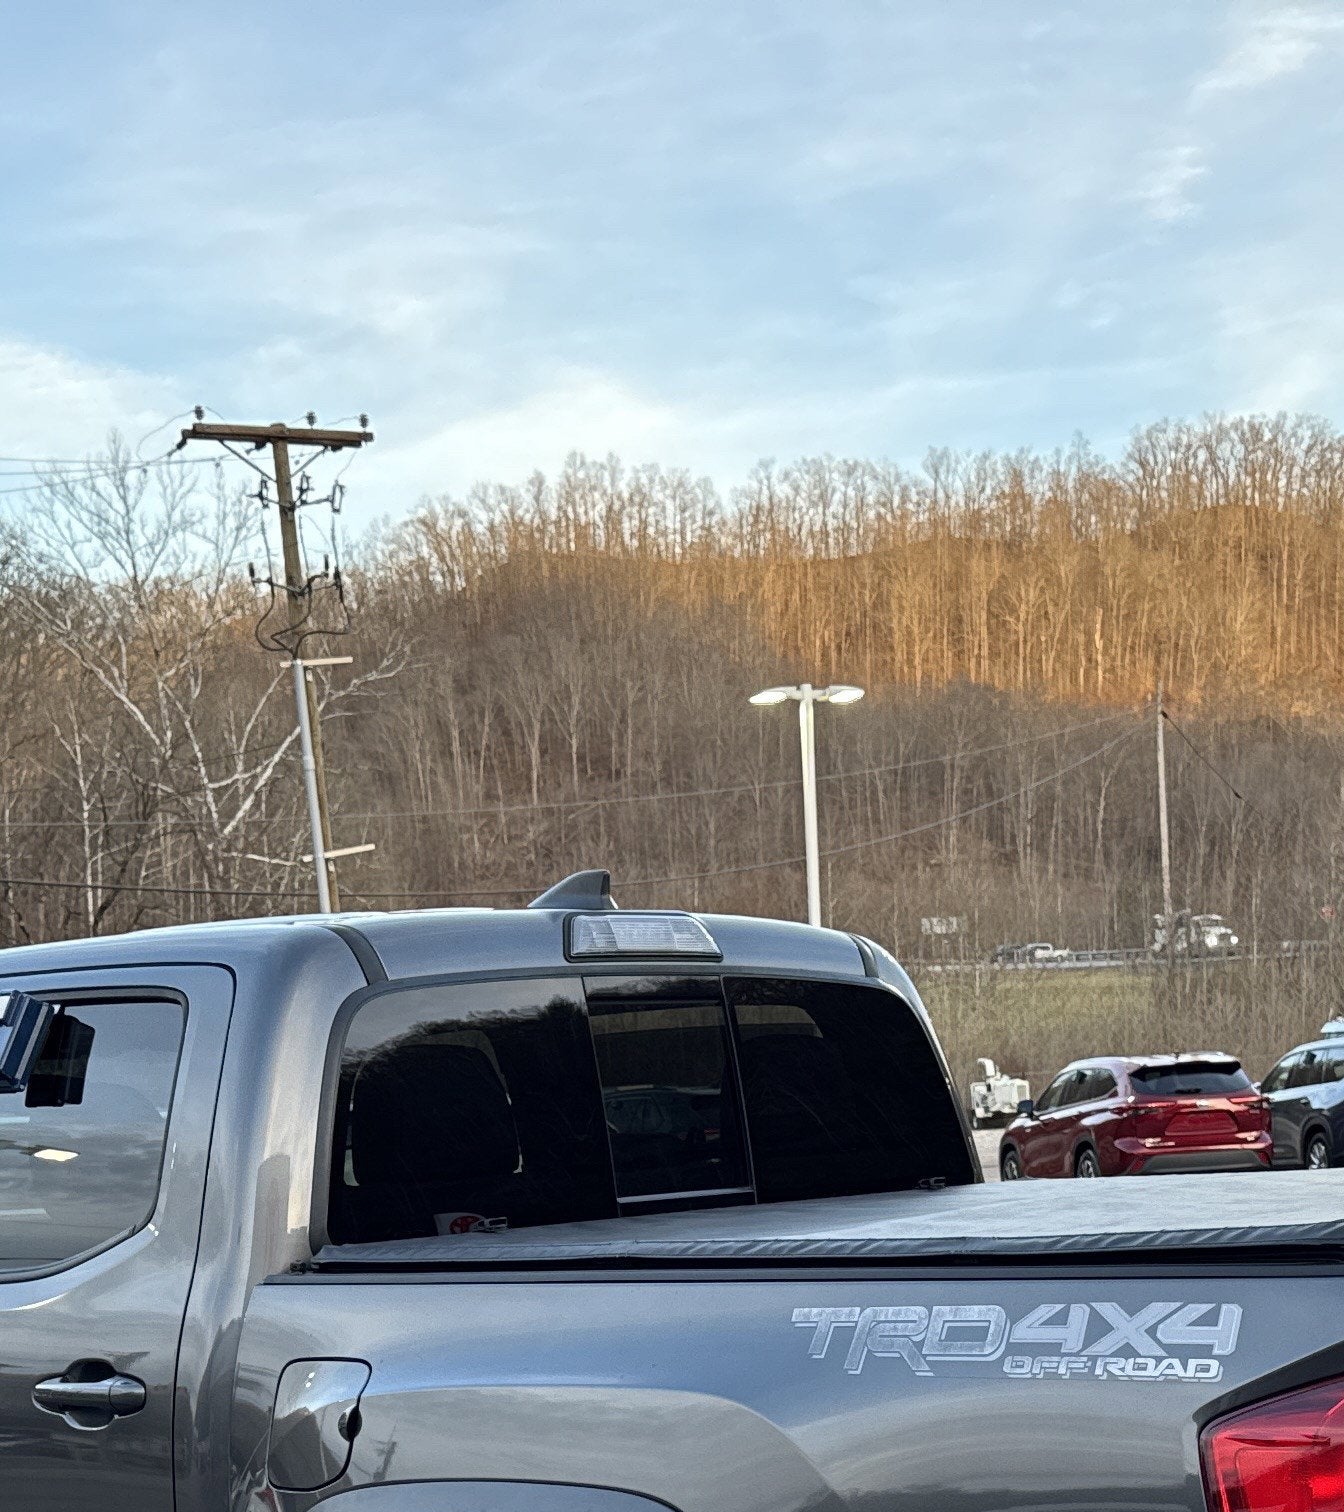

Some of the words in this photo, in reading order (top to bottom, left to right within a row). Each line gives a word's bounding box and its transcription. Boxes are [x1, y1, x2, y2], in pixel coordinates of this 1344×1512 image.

[791, 1305, 1010, 1376] TRD
[1003, 1356, 1089, 1379] OFF
[1094, 1357, 1224, 1383] ROAD
